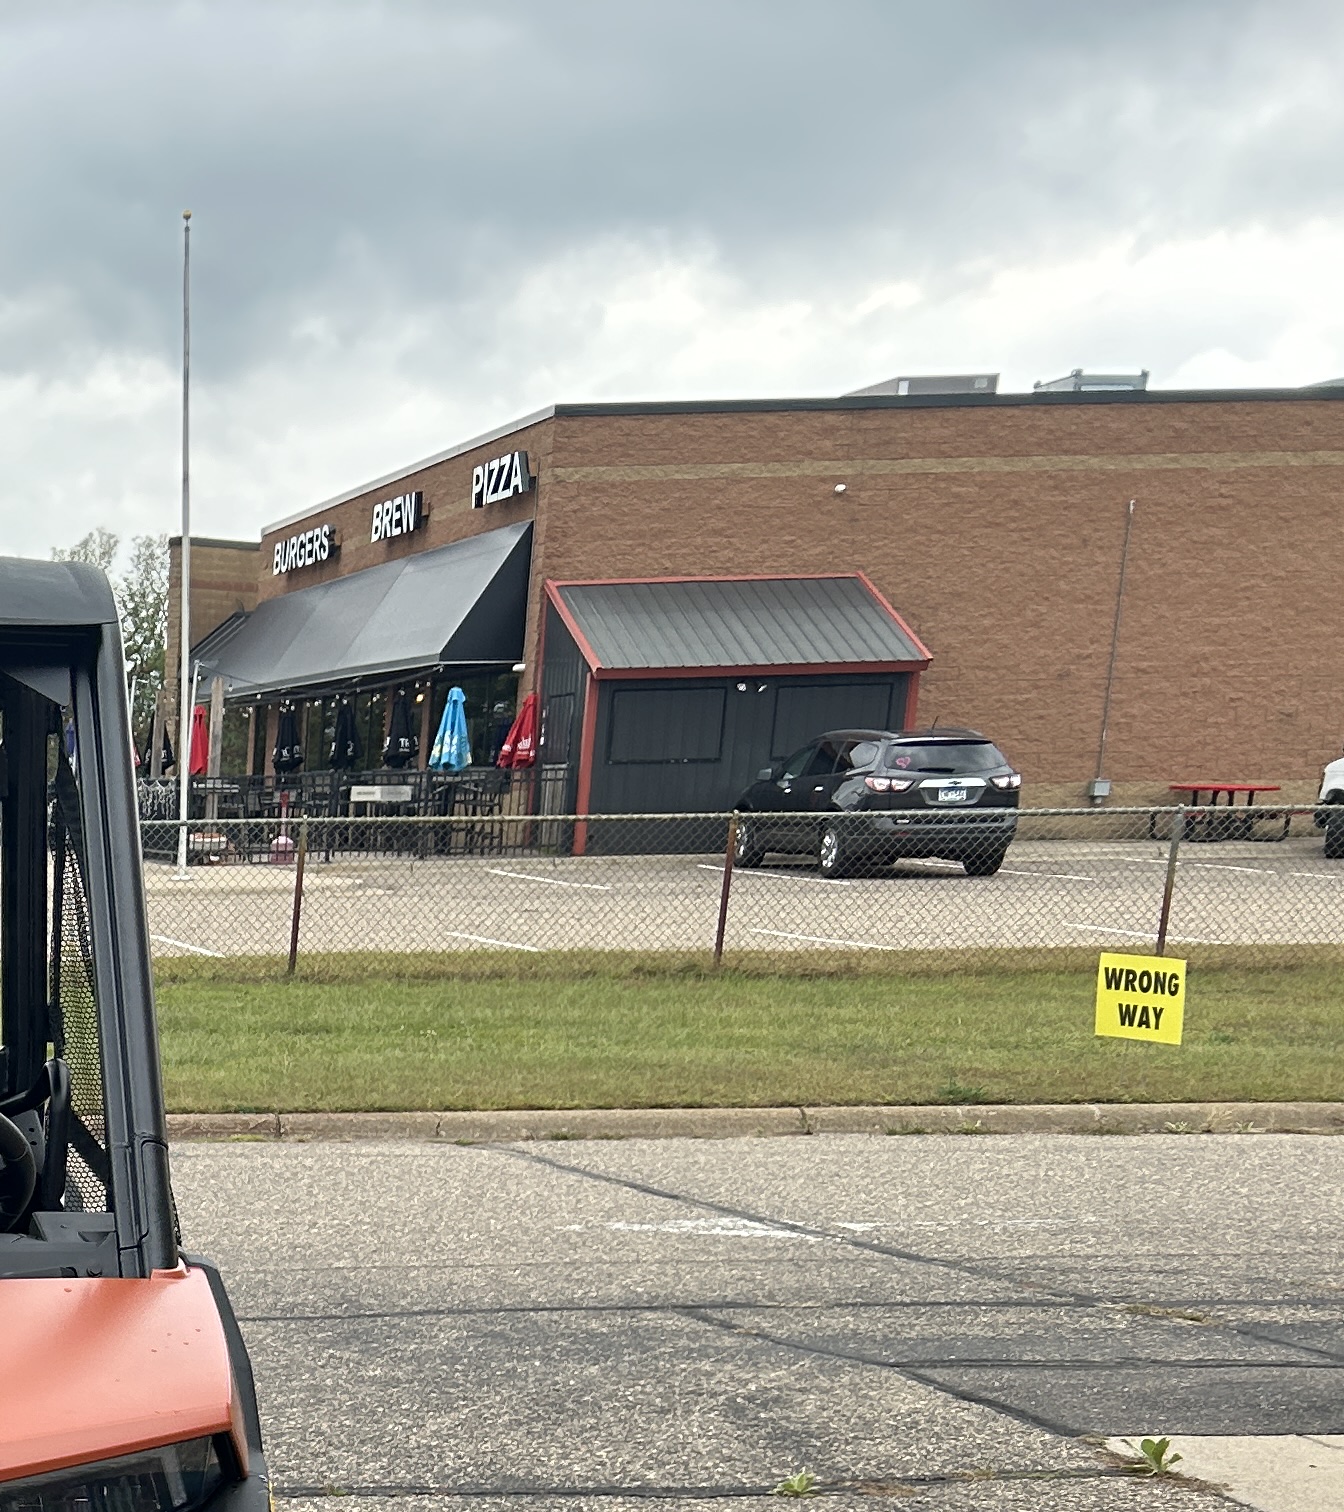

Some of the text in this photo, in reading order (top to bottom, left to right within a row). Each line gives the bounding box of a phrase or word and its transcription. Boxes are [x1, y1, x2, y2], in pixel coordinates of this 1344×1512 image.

[272, 451, 524, 576] BURGERS BREW PIZZA
[1104, 966, 1180, 997] WRONG
[1118, 1003, 1165, 1030] WAY
